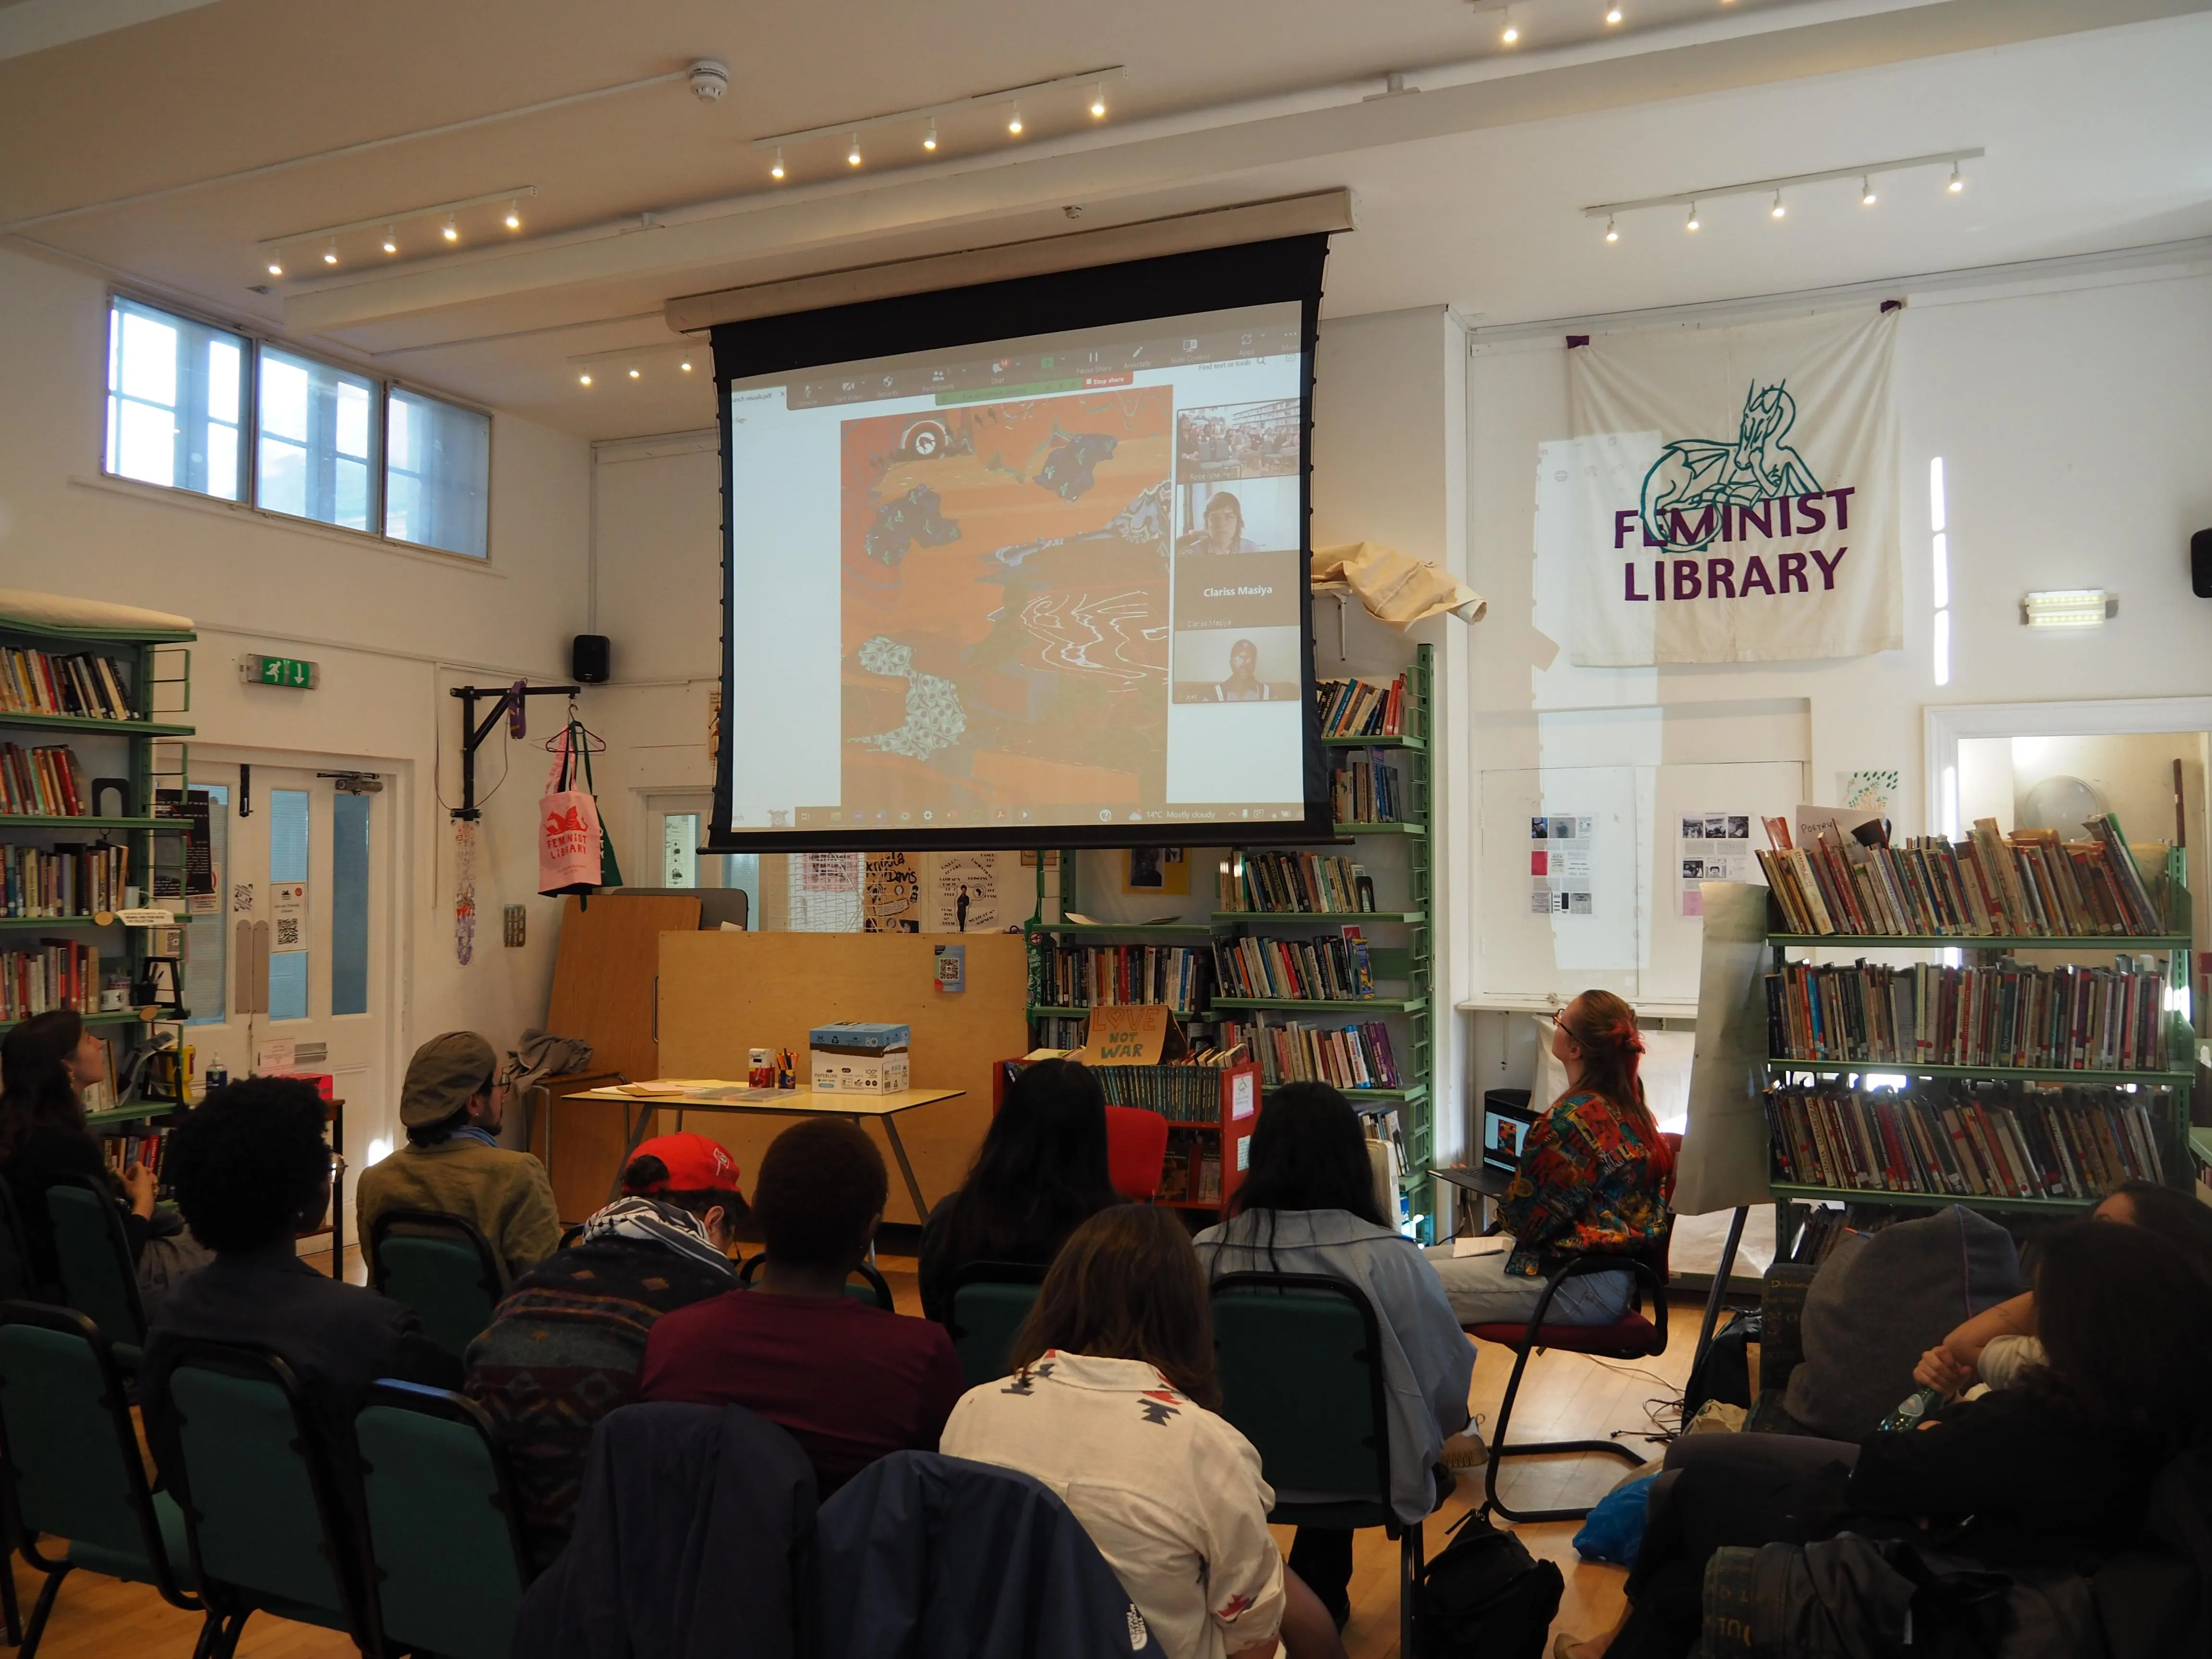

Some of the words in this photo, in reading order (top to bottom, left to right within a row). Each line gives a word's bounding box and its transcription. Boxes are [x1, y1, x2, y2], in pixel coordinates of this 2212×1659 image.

[1170, 355, 1185, 363] Slide
[1187, 353, 1210, 362] Control
[1123, 360, 1151, 370] Annotate
[1199, 362, 1212, 371] Find
[1076, 366, 1093, 375] Pause
[1094, 377, 1106, 385] Stop
[877, 389, 898, 397] Security
[922, 383, 954, 393] Participants
[848, 393, 863, 401] Video
[1614, 487, 1855, 549] FEMINIST
[1624, 547, 1848, 601] LIBRARY
[1203, 587, 1235, 597] Clariss
[1238, 585, 1272, 596] Masiya
[1166, 810, 1190, 820] Mostly
[1191, 810, 1215, 820] cloudy
[547, 833, 587, 849] FEMNIST
[887, 867, 917, 884] Davis
[1109, 1032, 1138, 1043] NOT
[1100, 1043, 1143, 1059] WAR
[1130, 1603, 1140, 1633] NORTH
